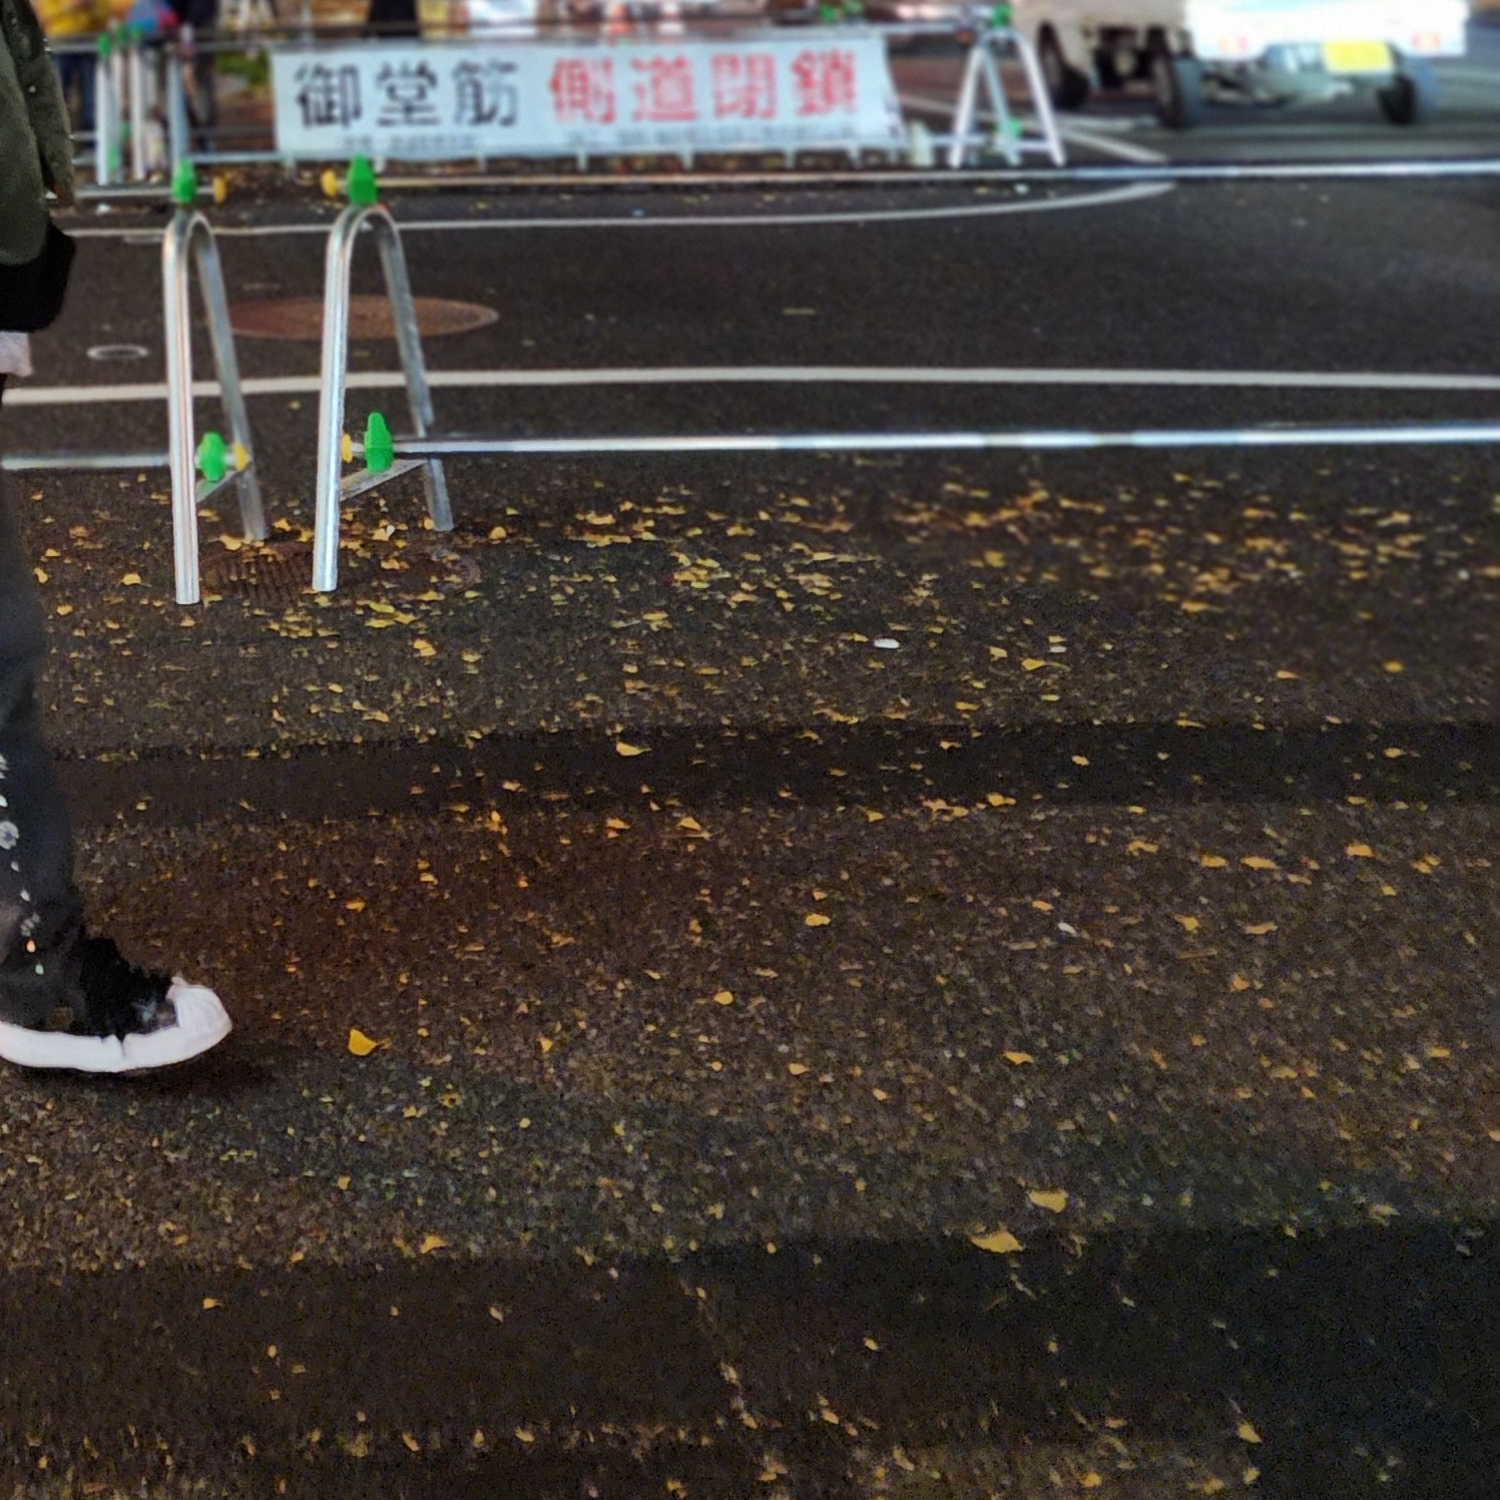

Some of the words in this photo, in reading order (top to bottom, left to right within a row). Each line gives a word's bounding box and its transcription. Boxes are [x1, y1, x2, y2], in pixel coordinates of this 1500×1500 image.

[294, 59, 518, 129] 御堂筋
[548, 47, 857, 125] 側道閉鎖
